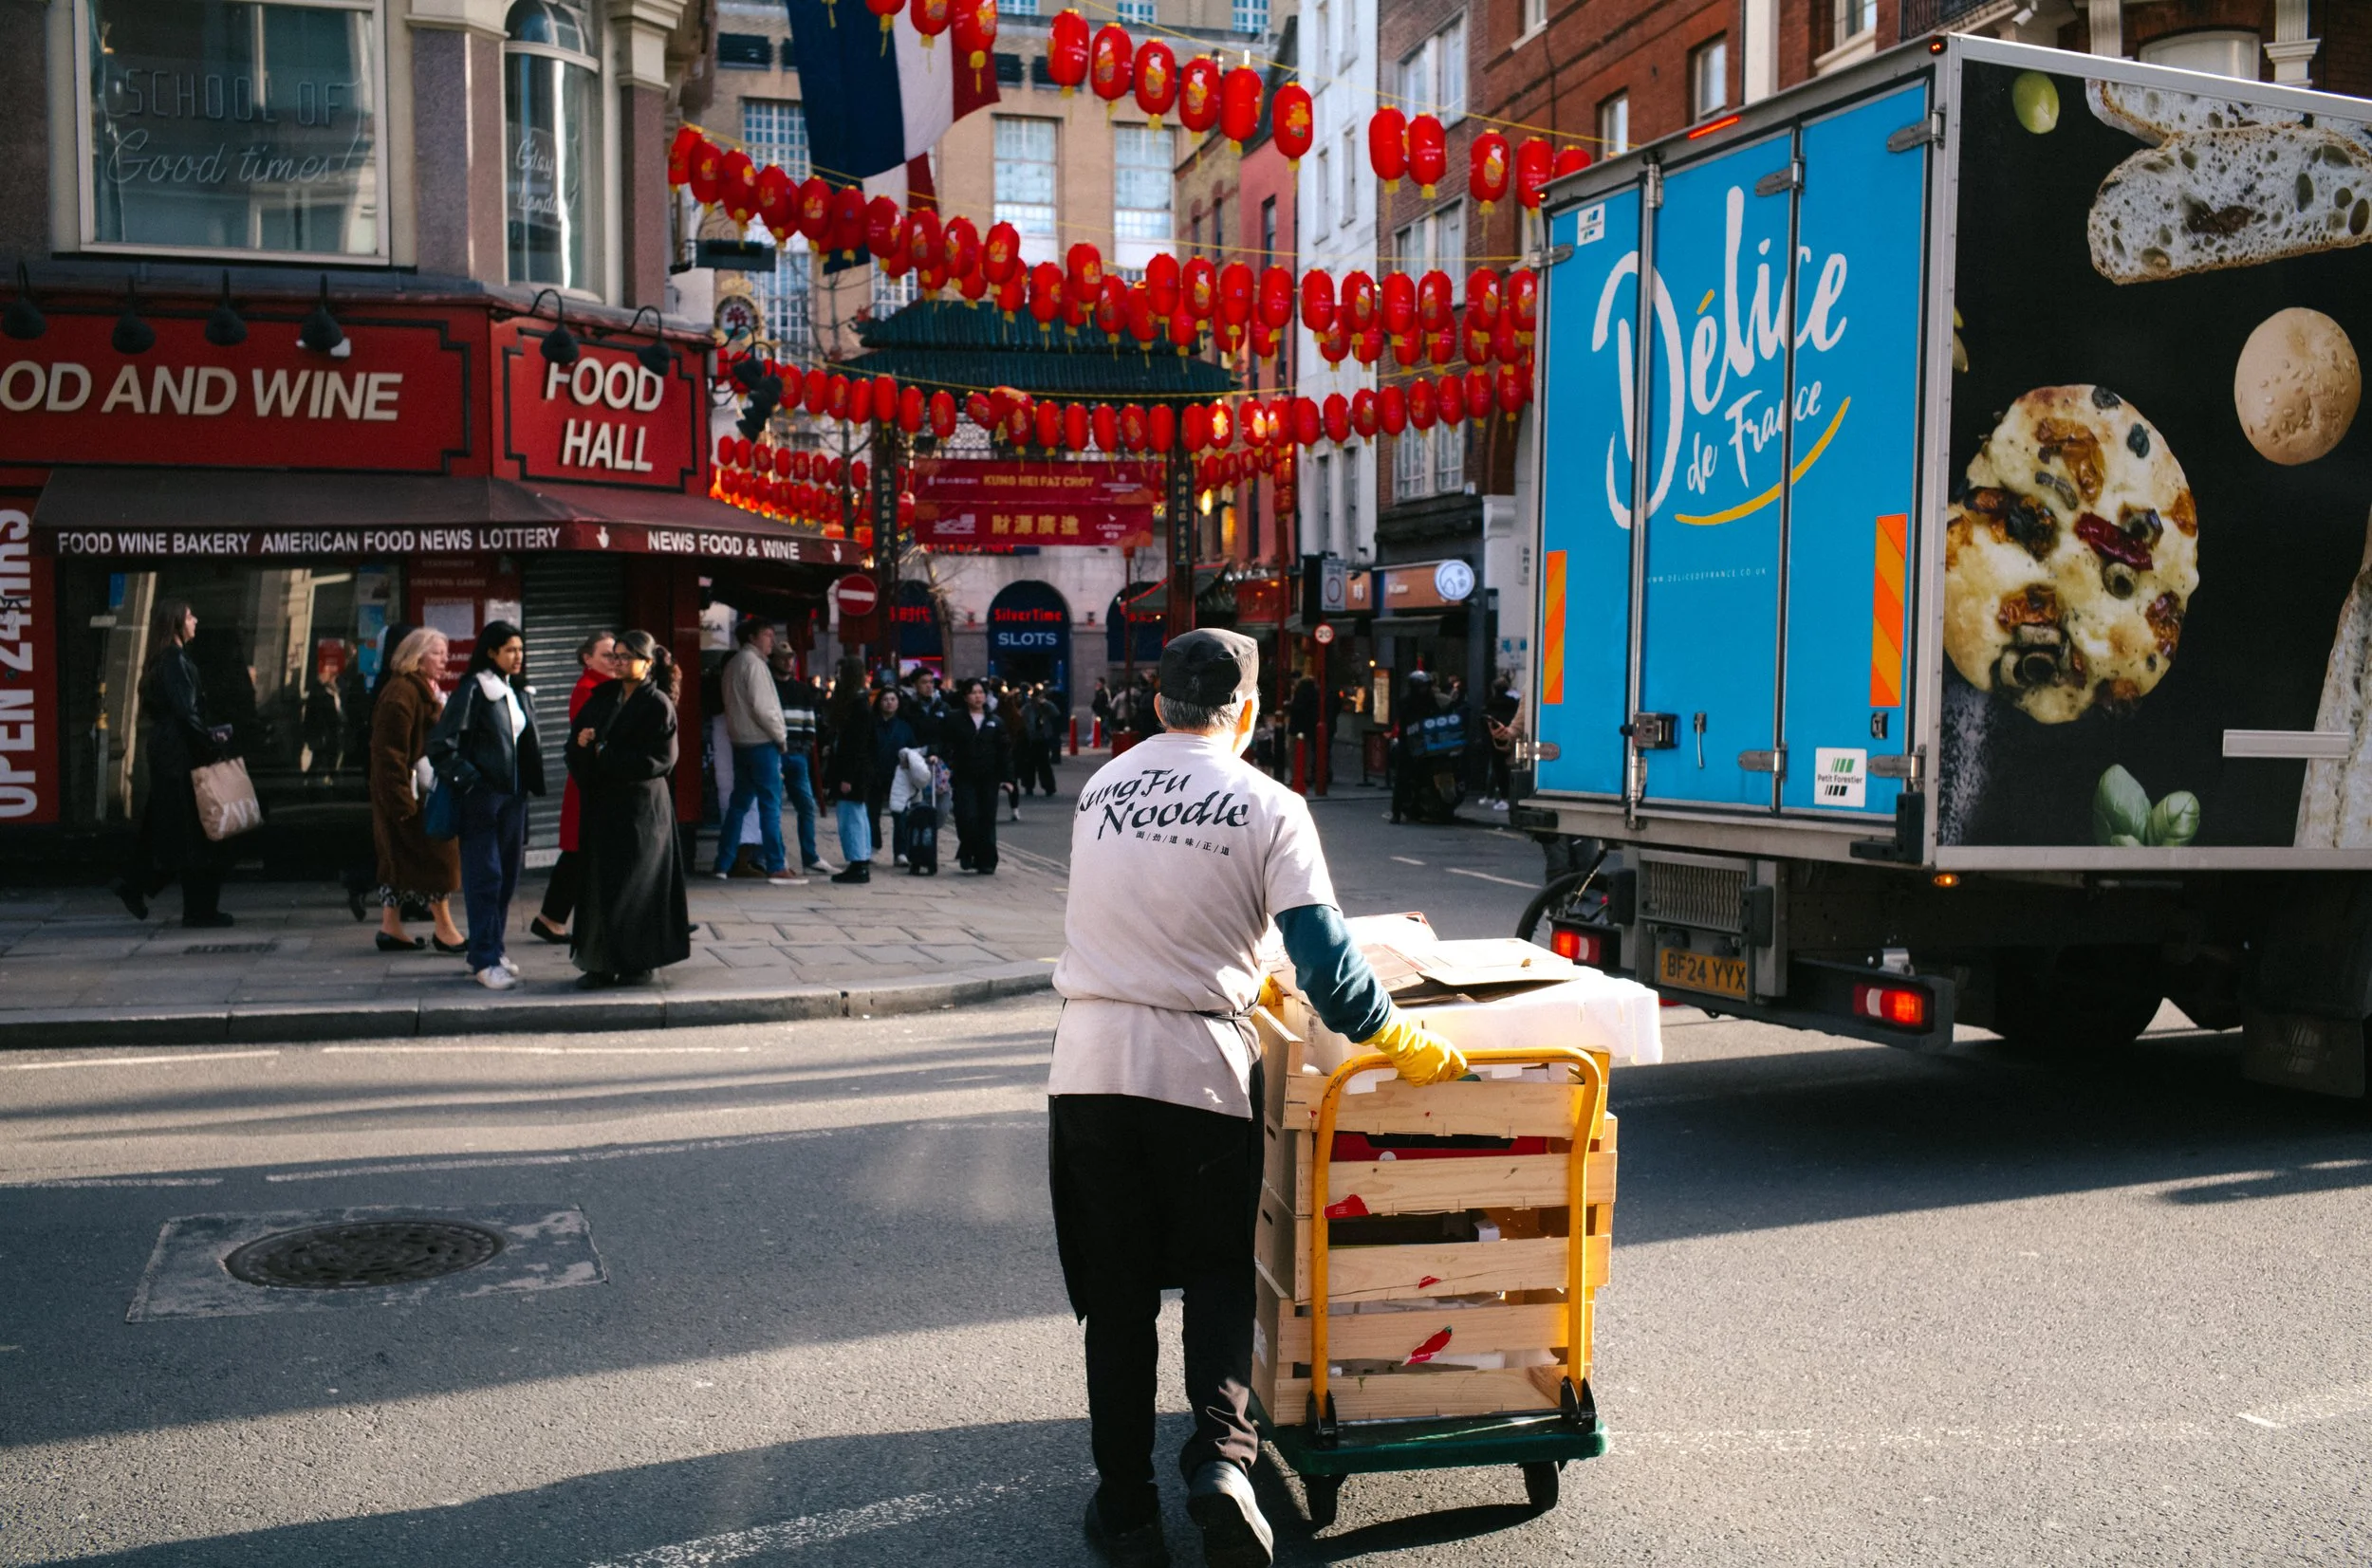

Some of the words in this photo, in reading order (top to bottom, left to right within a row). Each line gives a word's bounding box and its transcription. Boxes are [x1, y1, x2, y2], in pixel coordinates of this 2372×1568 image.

[125, 68, 278, 124] SCHOOL
[297, 81, 344, 126] OF
[106, 128, 229, 184] Good
[238, 133, 361, 184] times!
[1591, 185, 1848, 530] Délice
[0, 360, 93, 413] OD
[101, 364, 238, 416] AND
[251, 368, 404, 422] WINE
[547, 357, 664, 413] FOOD
[562, 418, 654, 472] HALL
[1687, 432, 1718, 495] de
[1063, 476, 1095, 488] CHOY
[58, 532, 113, 554] FOOD
[118, 532, 168, 554] WINE
[173, 532, 251, 554] BAKERY
[261, 530, 359, 554] AMERICAN
[363, 529, 416, 553] FOOD
[420, 528, 473, 551] NEWS
[479, 526, 561, 550] LOTTERY
[647, 530, 695, 553] NEWS
[699, 533, 743, 556] FOOD
[746, 538, 759, 557] &
[761, 539, 801, 561] WINE
[994, 608, 1063, 622] SilverTime
[997, 632, 1057, 646] SLOTS
[1318, 630, 1332, 638] 20
[0, 689, 38, 819] OPEN
[1140, 767, 1193, 799] Fu
[1097, 789, 1252, 841] Noodle
[1666, 951, 1707, 985] BF24
[1712, 957, 1746, 992] YYX
